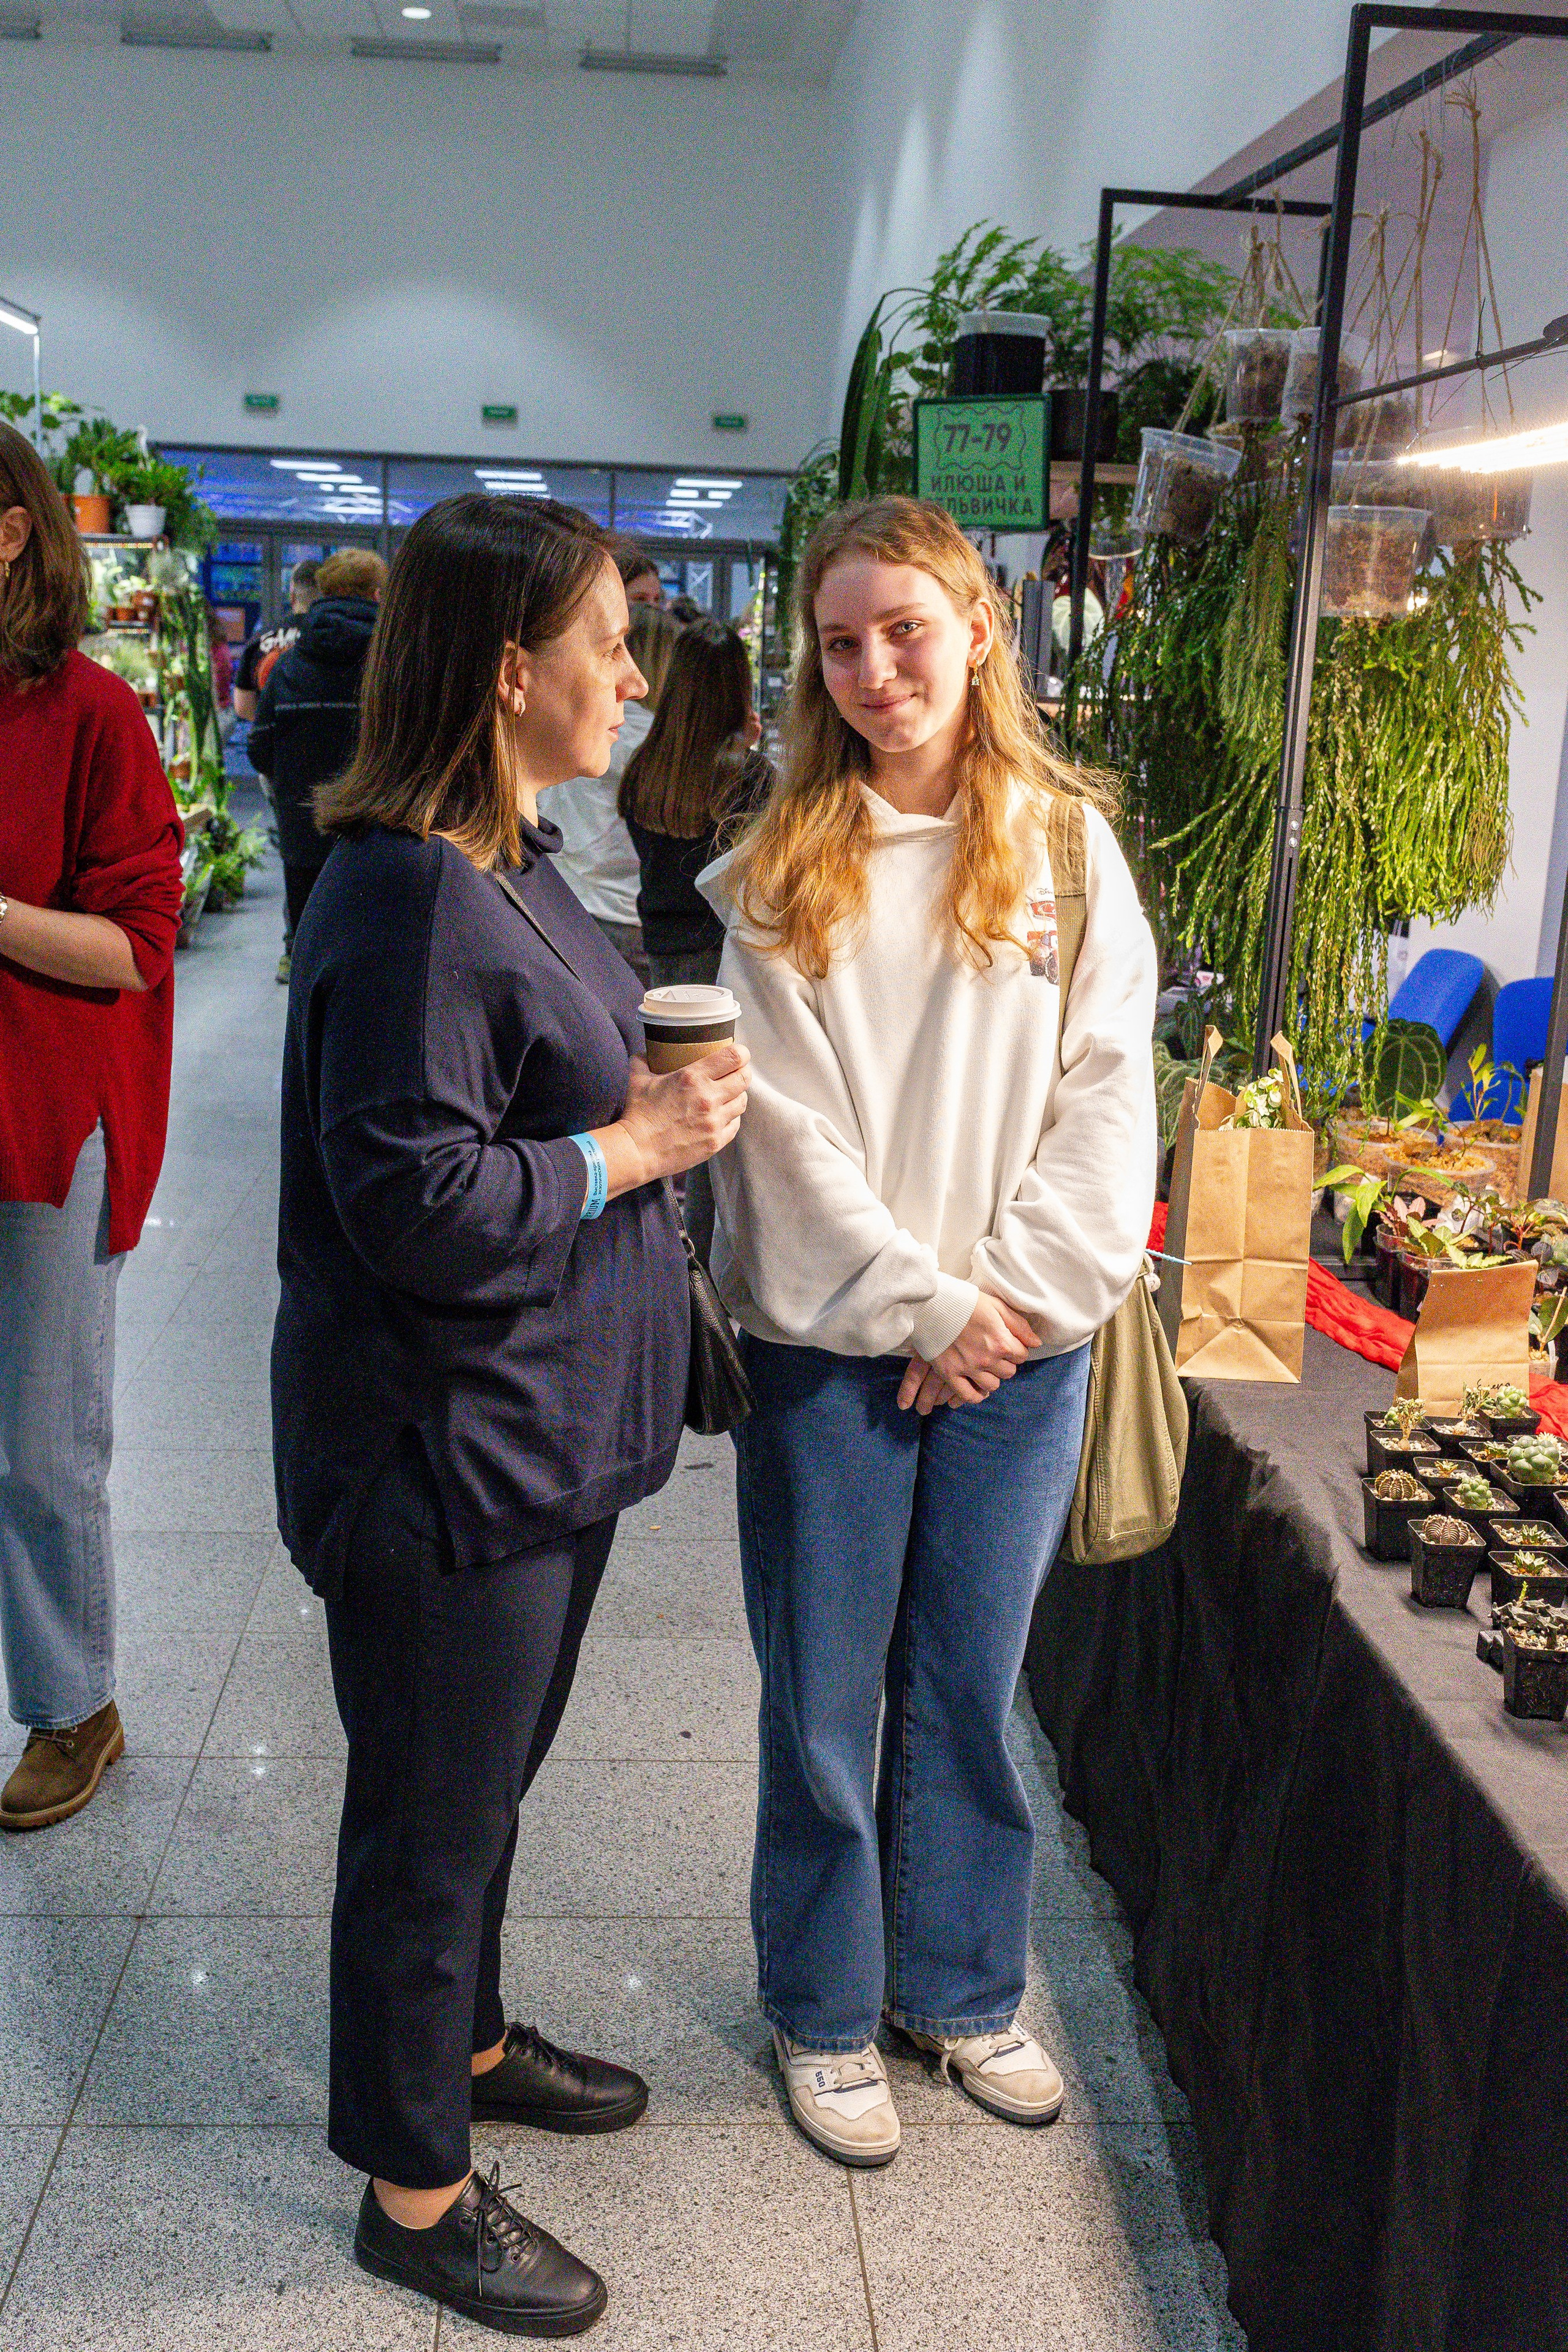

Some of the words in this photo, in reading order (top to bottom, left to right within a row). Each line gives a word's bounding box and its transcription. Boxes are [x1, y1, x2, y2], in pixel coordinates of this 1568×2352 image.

[943, 423, 1012, 453] 77-79
[931, 474, 1006, 492] ИЛЮША
[1014, 474, 1026, 492] И
[815, 2070, 825, 2087] 550
